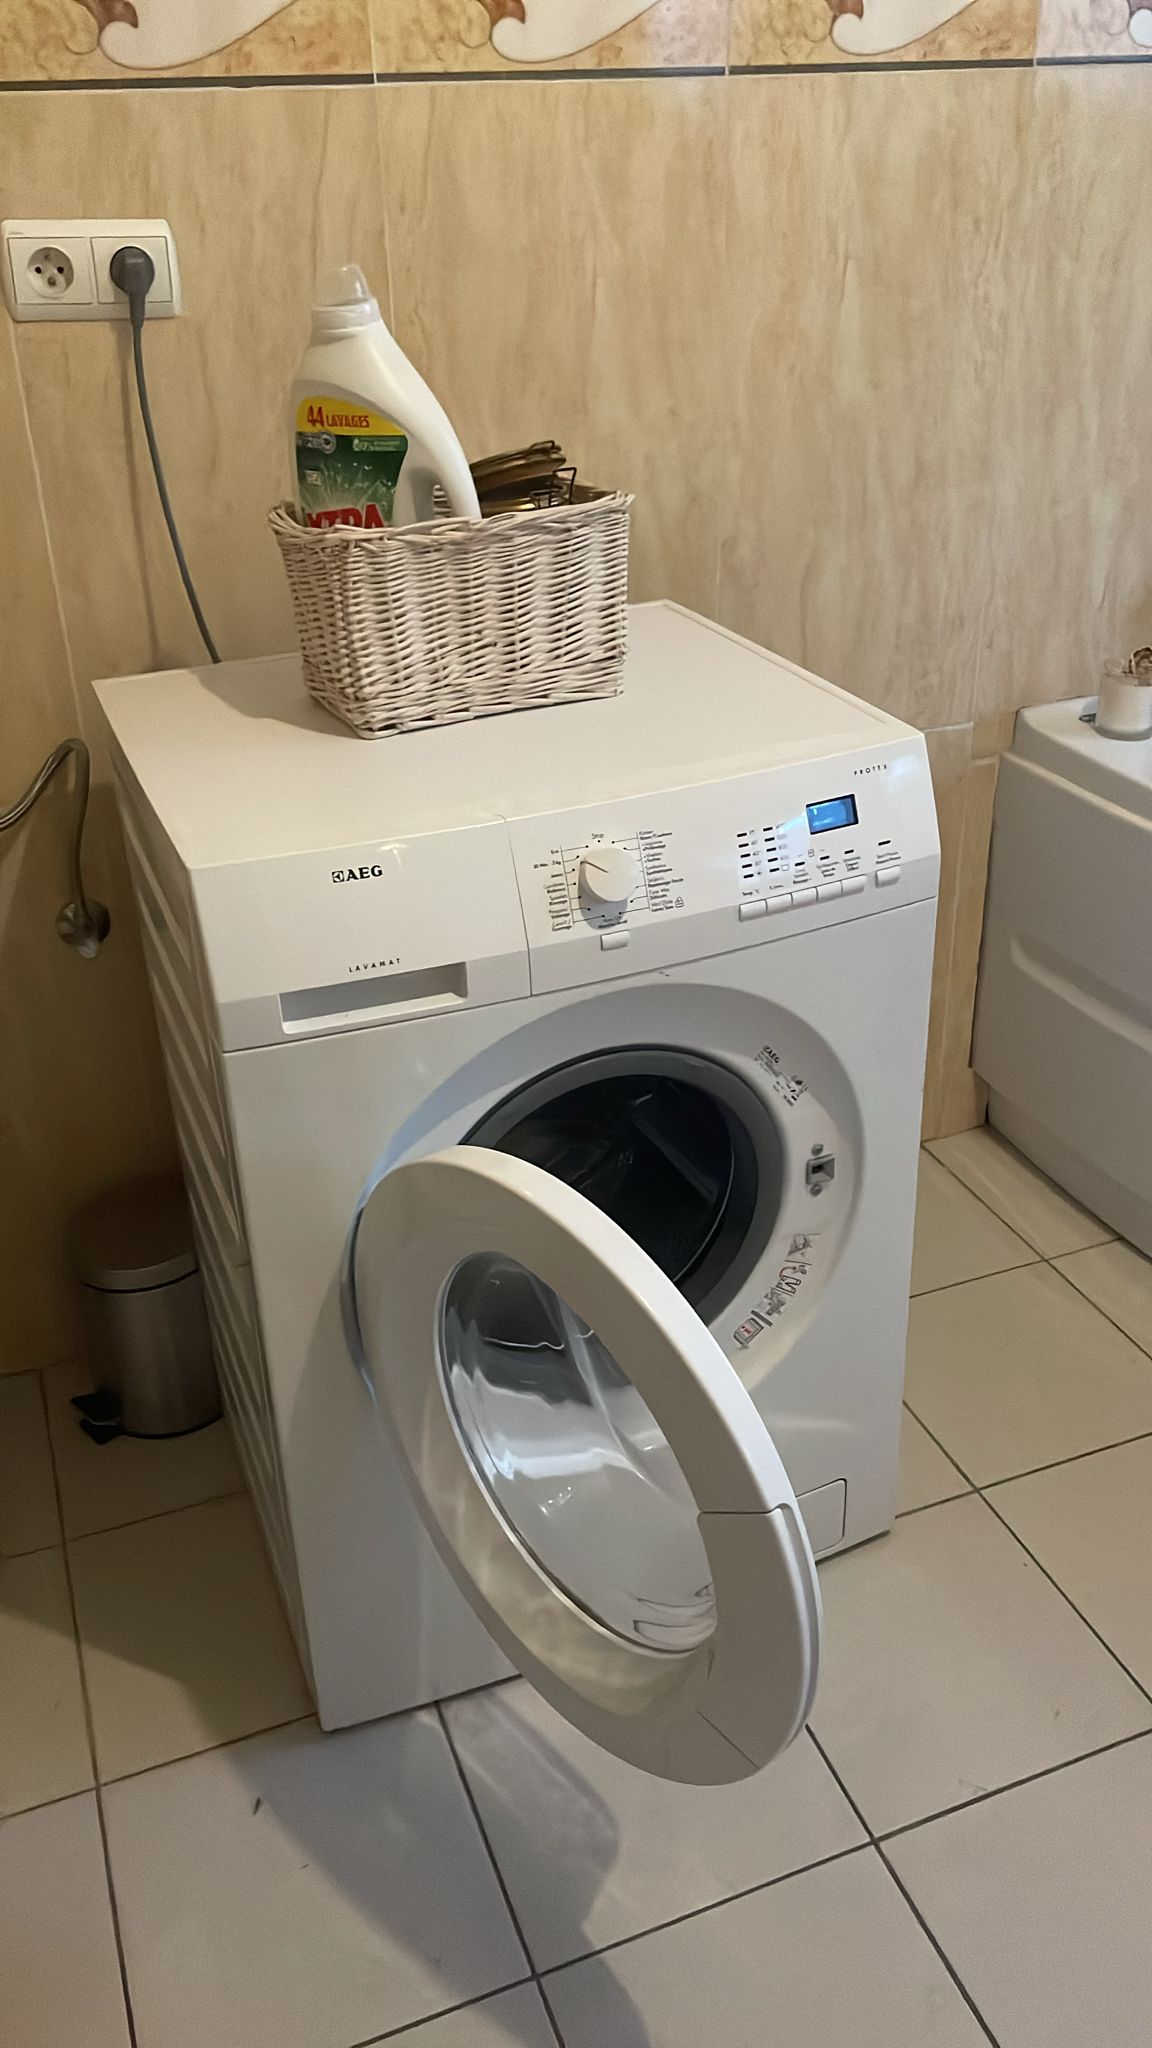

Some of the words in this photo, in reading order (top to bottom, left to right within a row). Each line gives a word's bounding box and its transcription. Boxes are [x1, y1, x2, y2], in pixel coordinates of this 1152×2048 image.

[307, 404, 325, 428] 44
[326, 414, 370, 428] LAVAGES
[346, 865, 383, 881] AEG
[348, 958, 400, 973] LAVAMAT
